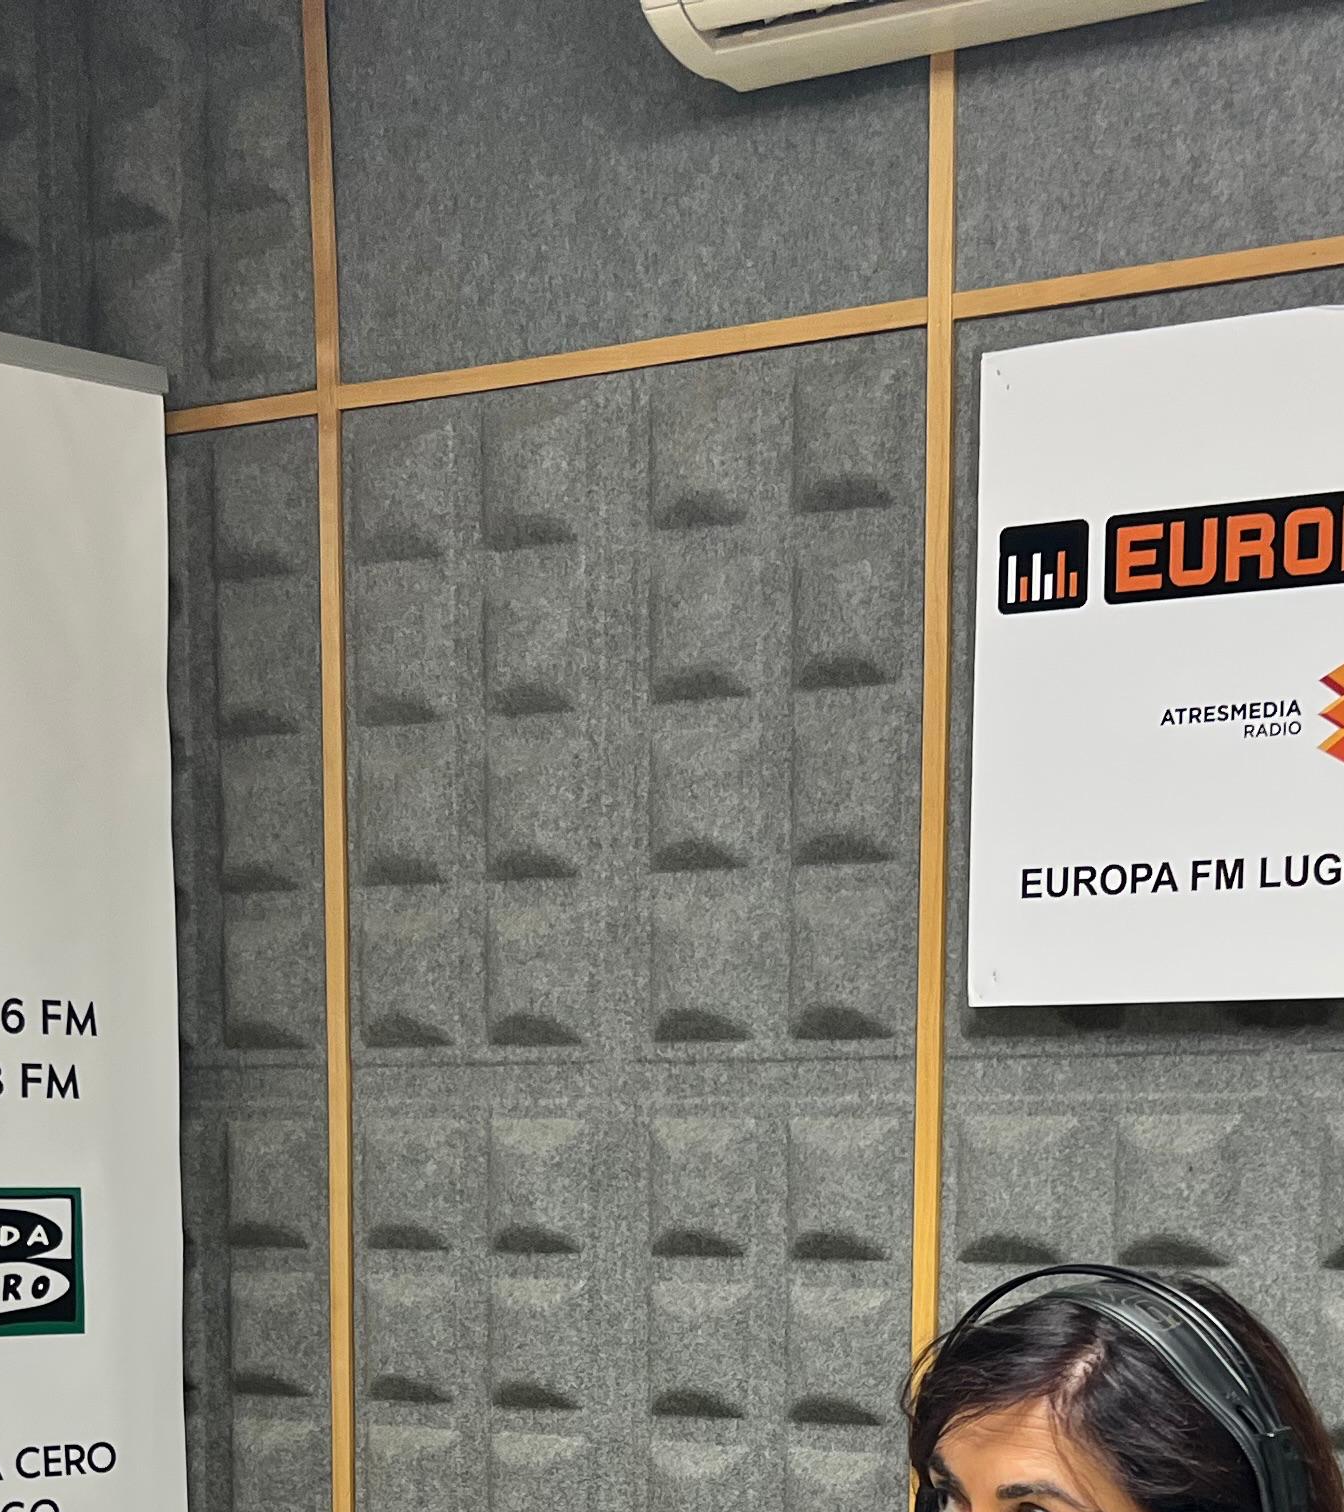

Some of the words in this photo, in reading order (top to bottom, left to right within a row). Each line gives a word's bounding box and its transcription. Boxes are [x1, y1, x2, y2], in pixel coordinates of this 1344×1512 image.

[1160, 699, 1302, 727] ATRESMEDIA
[1242, 721, 1303, 740] RADIO
[1021, 861, 1179, 899] EUROPA
[1191, 858, 1245, 891] FM
[41, 999, 98, 1037] FM
[21, 1062, 80, 1100] FM
[15, 1441, 117, 1479] CERO
